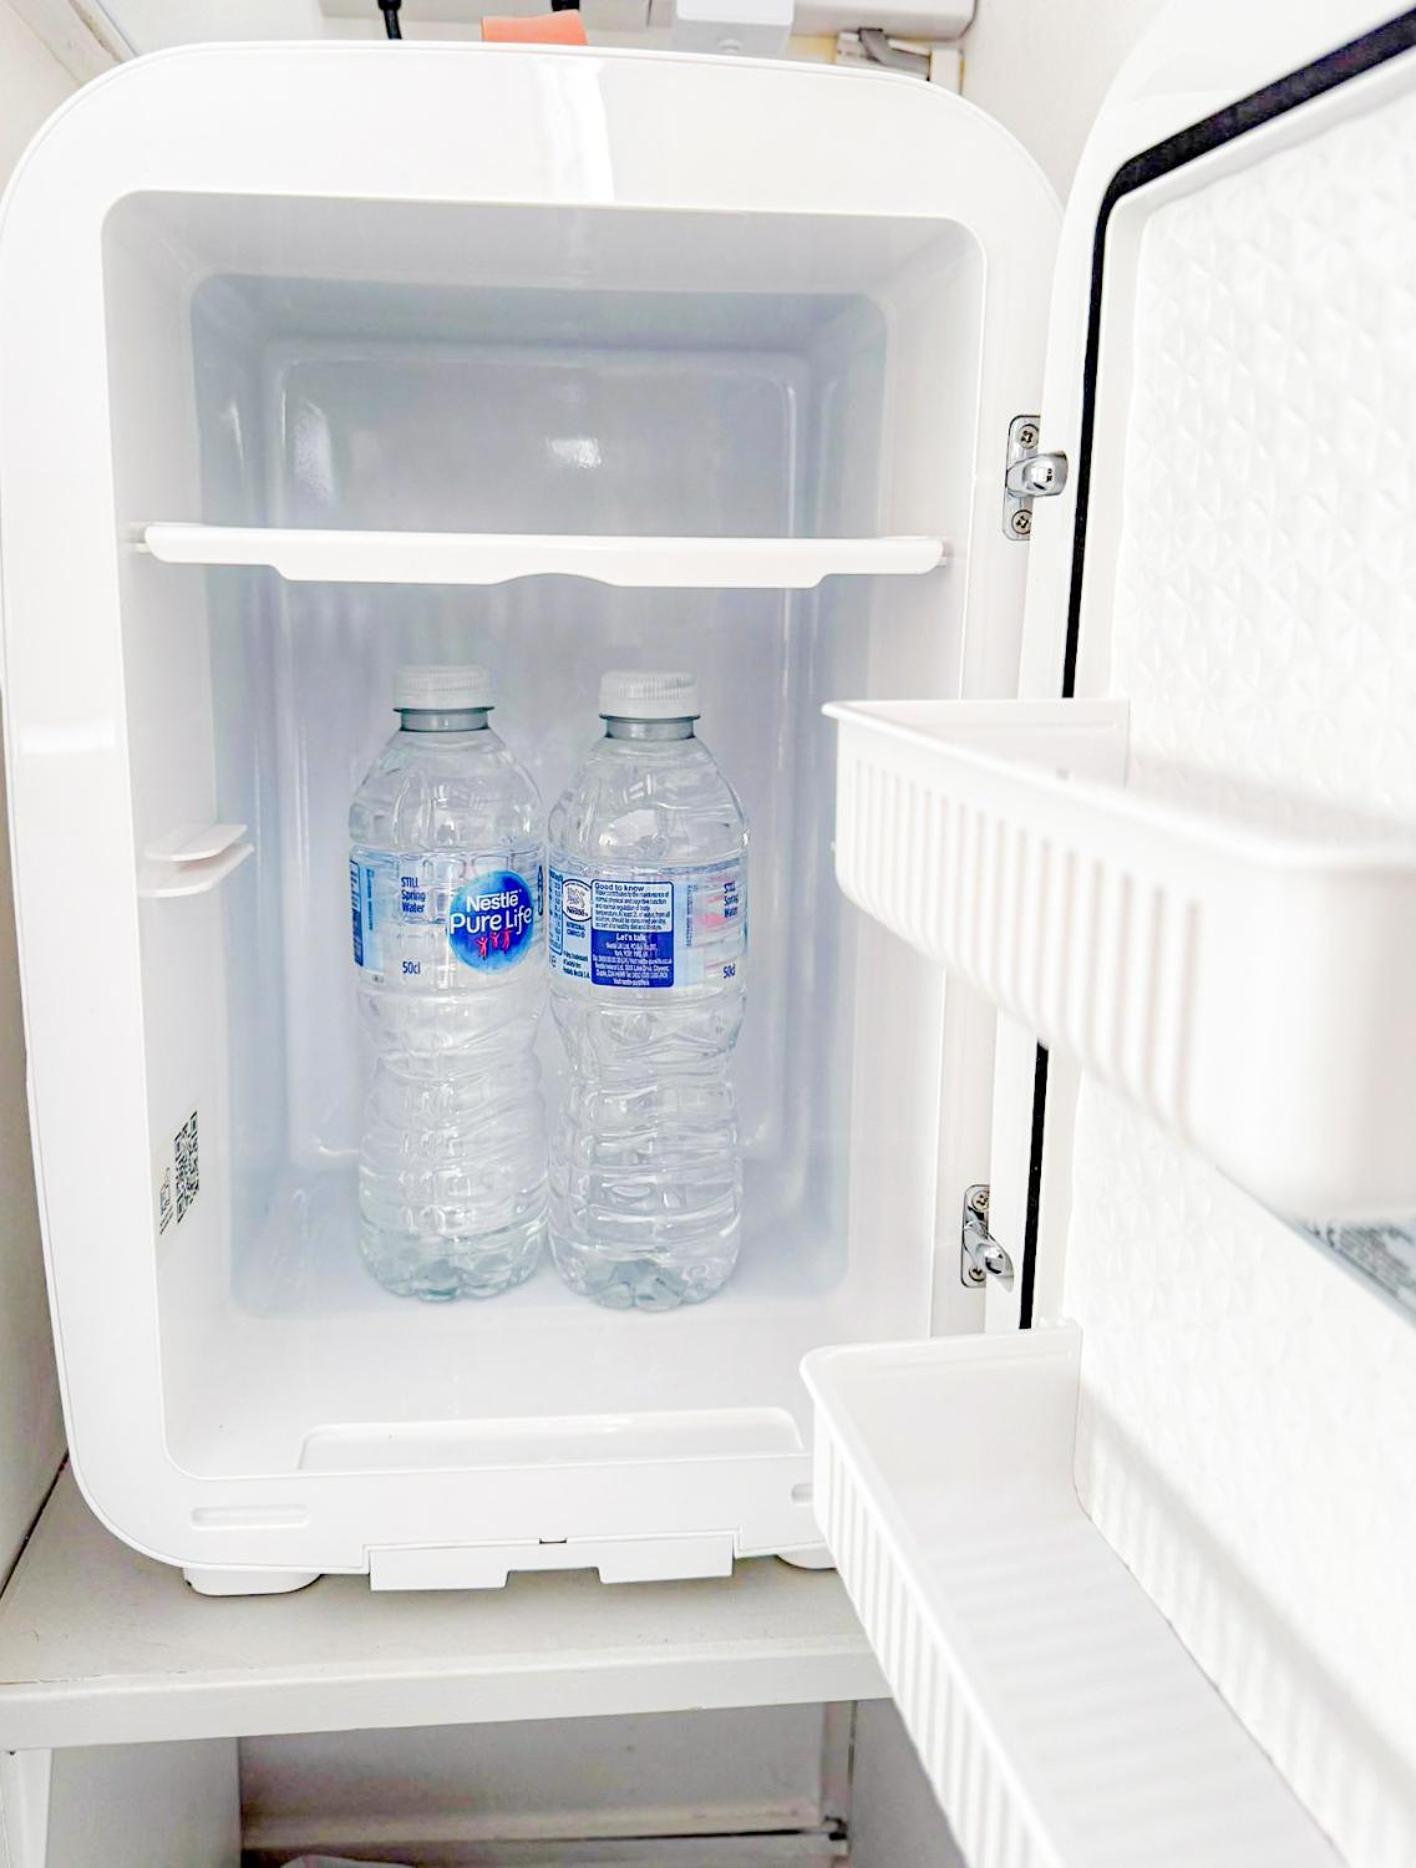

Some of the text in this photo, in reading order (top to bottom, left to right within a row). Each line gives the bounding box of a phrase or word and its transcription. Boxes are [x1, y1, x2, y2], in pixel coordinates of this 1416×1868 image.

[401, 876, 419, 888] STILL
[595, 882, 614, 891] Good
[624, 884, 645, 892] know
[401, 889, 426, 902] Spring
[401, 901, 425, 913] Water
[450, 906, 533, 935] Pure Life
[402, 961, 421, 974] 50cl
